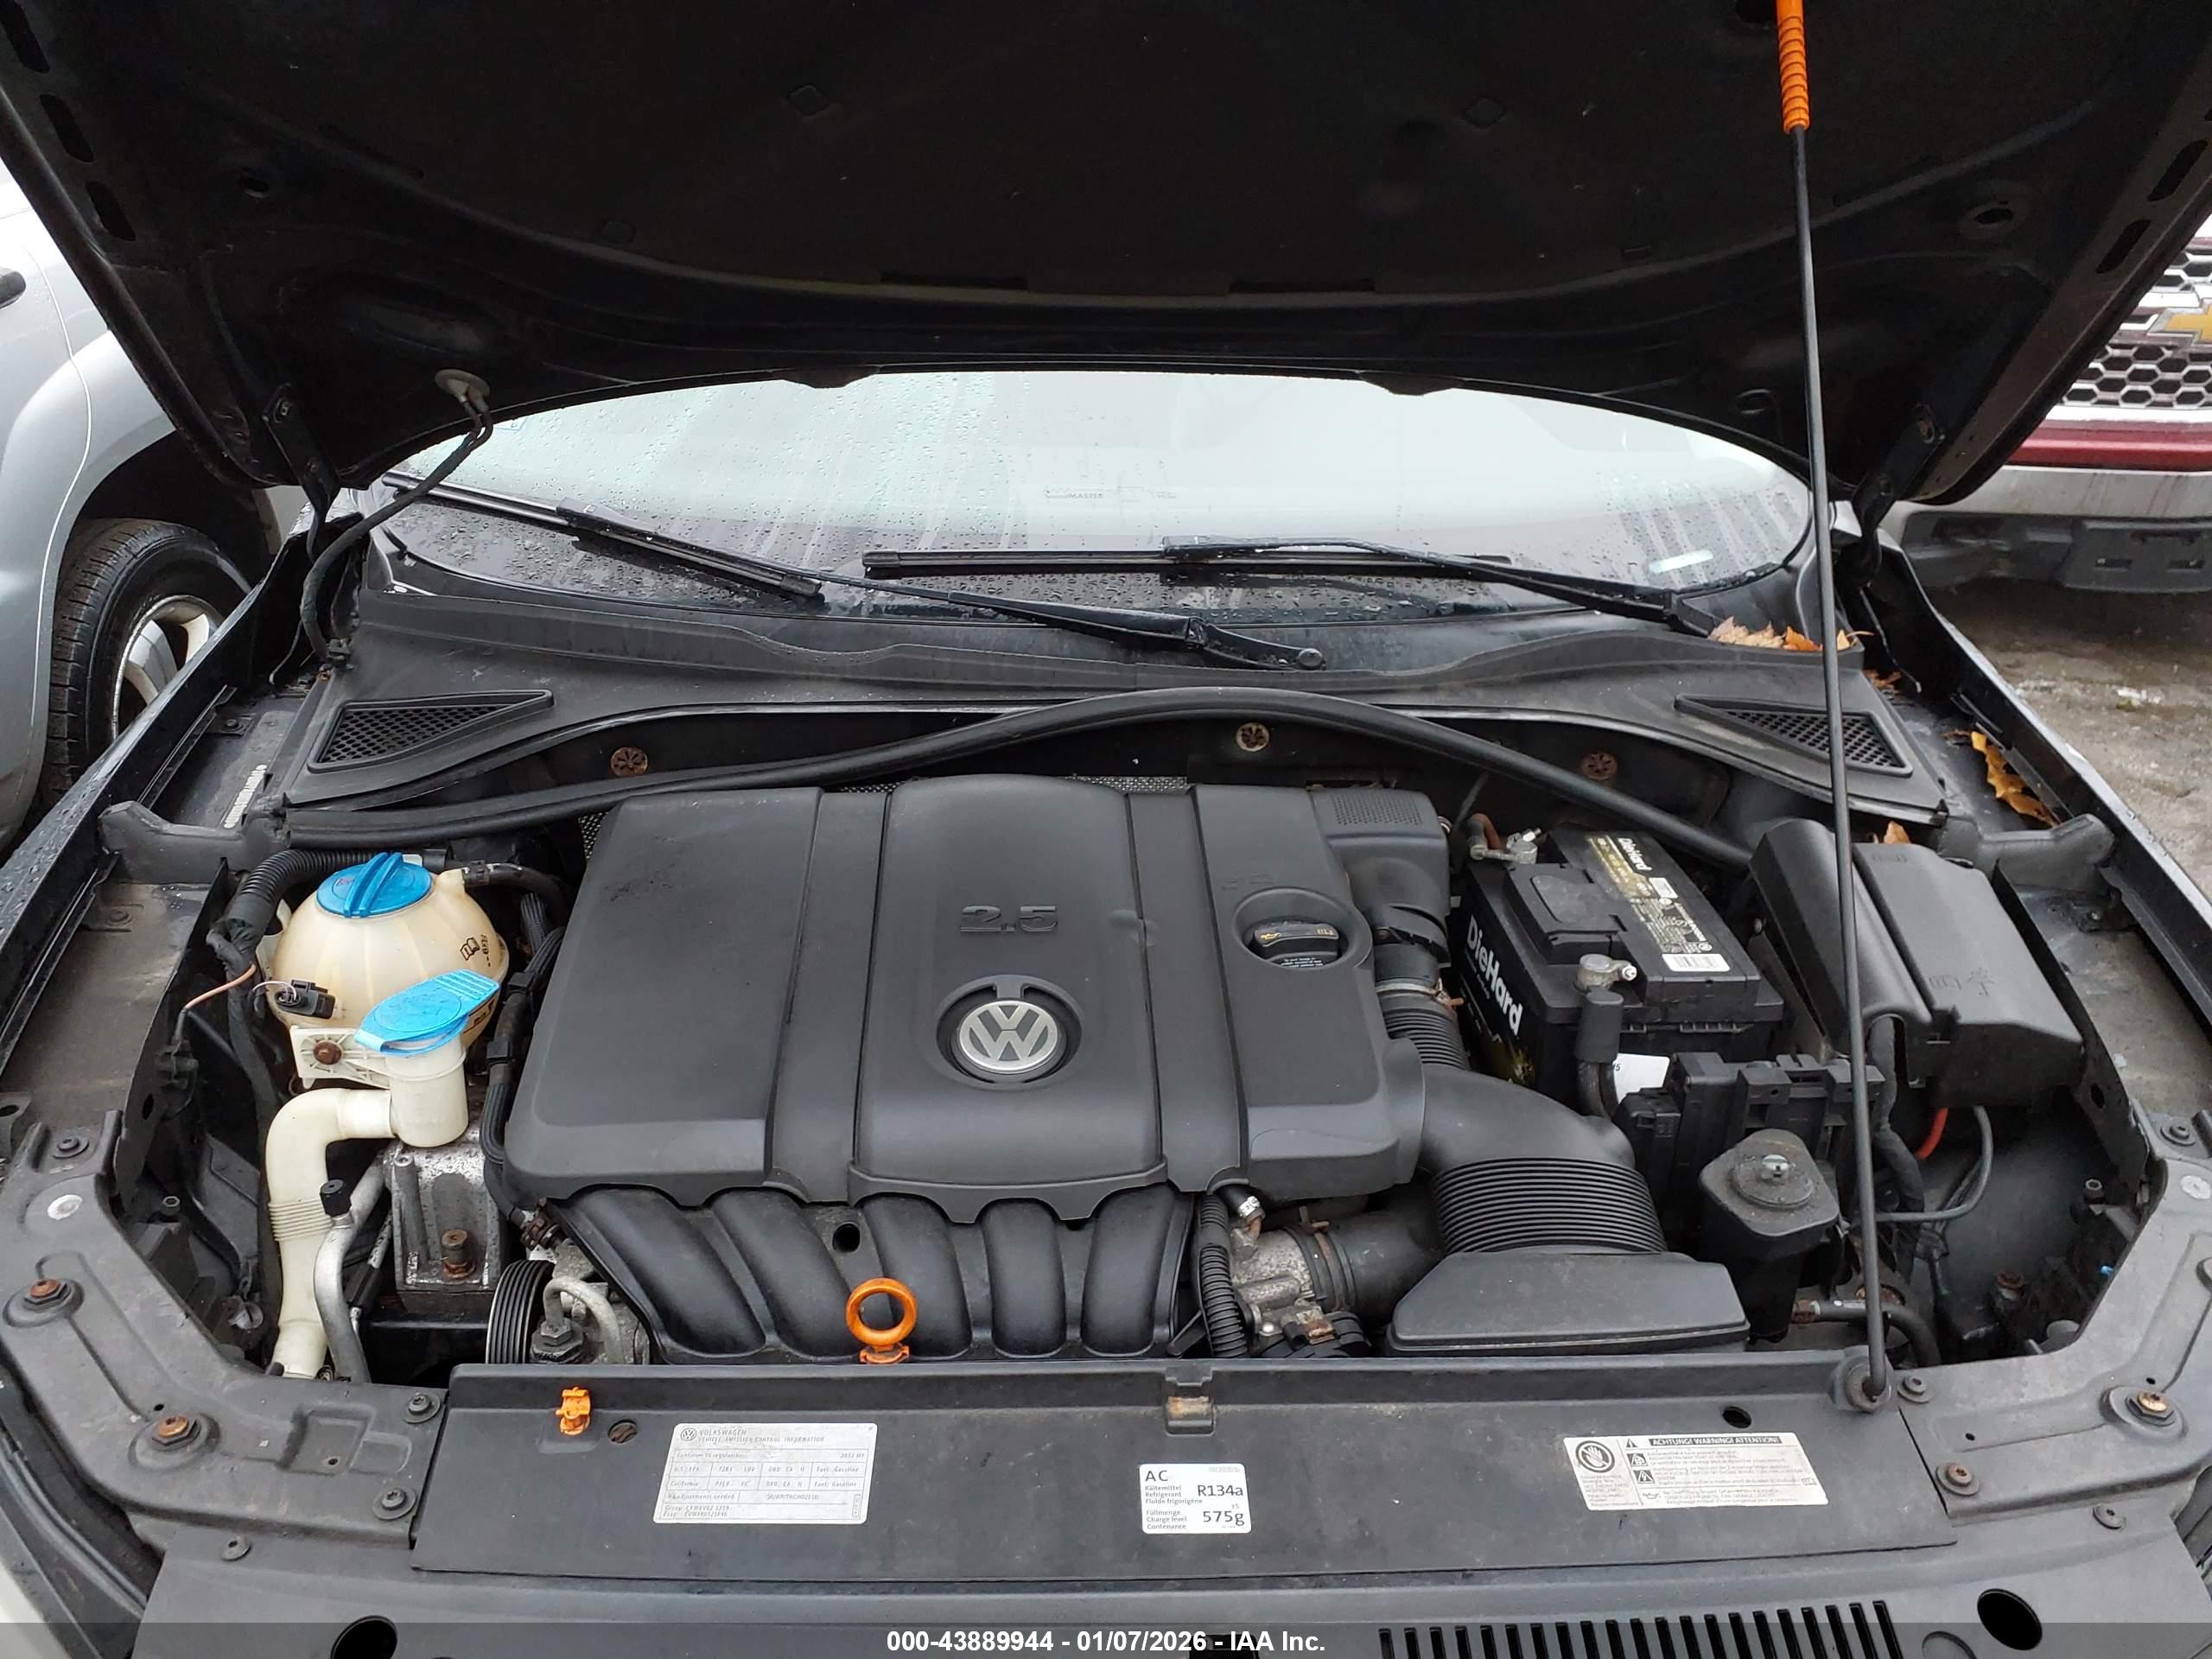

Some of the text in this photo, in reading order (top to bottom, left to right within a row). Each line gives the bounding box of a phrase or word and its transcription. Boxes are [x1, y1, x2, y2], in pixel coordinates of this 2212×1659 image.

[1618, 837, 1652, 871] DieHard
[960, 905, 1058, 932] 2.5
[1467, 914, 1523, 1035] DieHard
[1145, 1470, 1169, 1482] AC
[1197, 1484, 1244, 1497] R134a
[1146, 1509, 1181, 1517] Füllmenge
[1203, 1510, 1244, 1527] 575g
